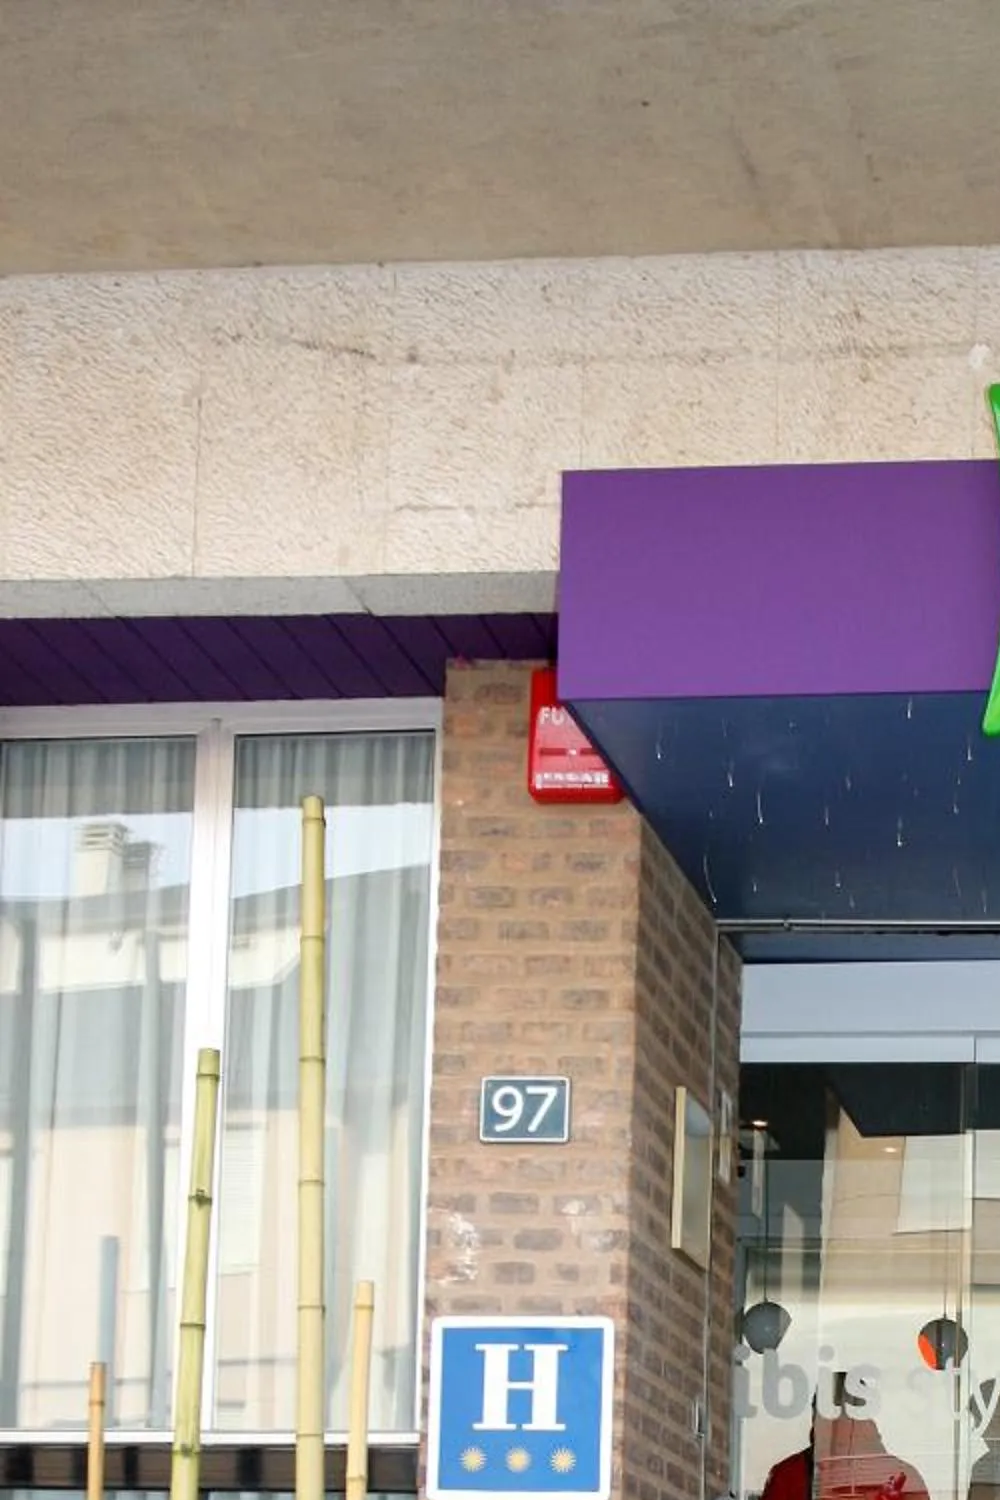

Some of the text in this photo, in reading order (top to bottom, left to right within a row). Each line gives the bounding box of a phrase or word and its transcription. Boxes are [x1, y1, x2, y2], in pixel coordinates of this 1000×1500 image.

[491, 1085, 559, 1132] 97
[473, 1343, 569, 1431] H
[731, 1344, 882, 1420] ibis
